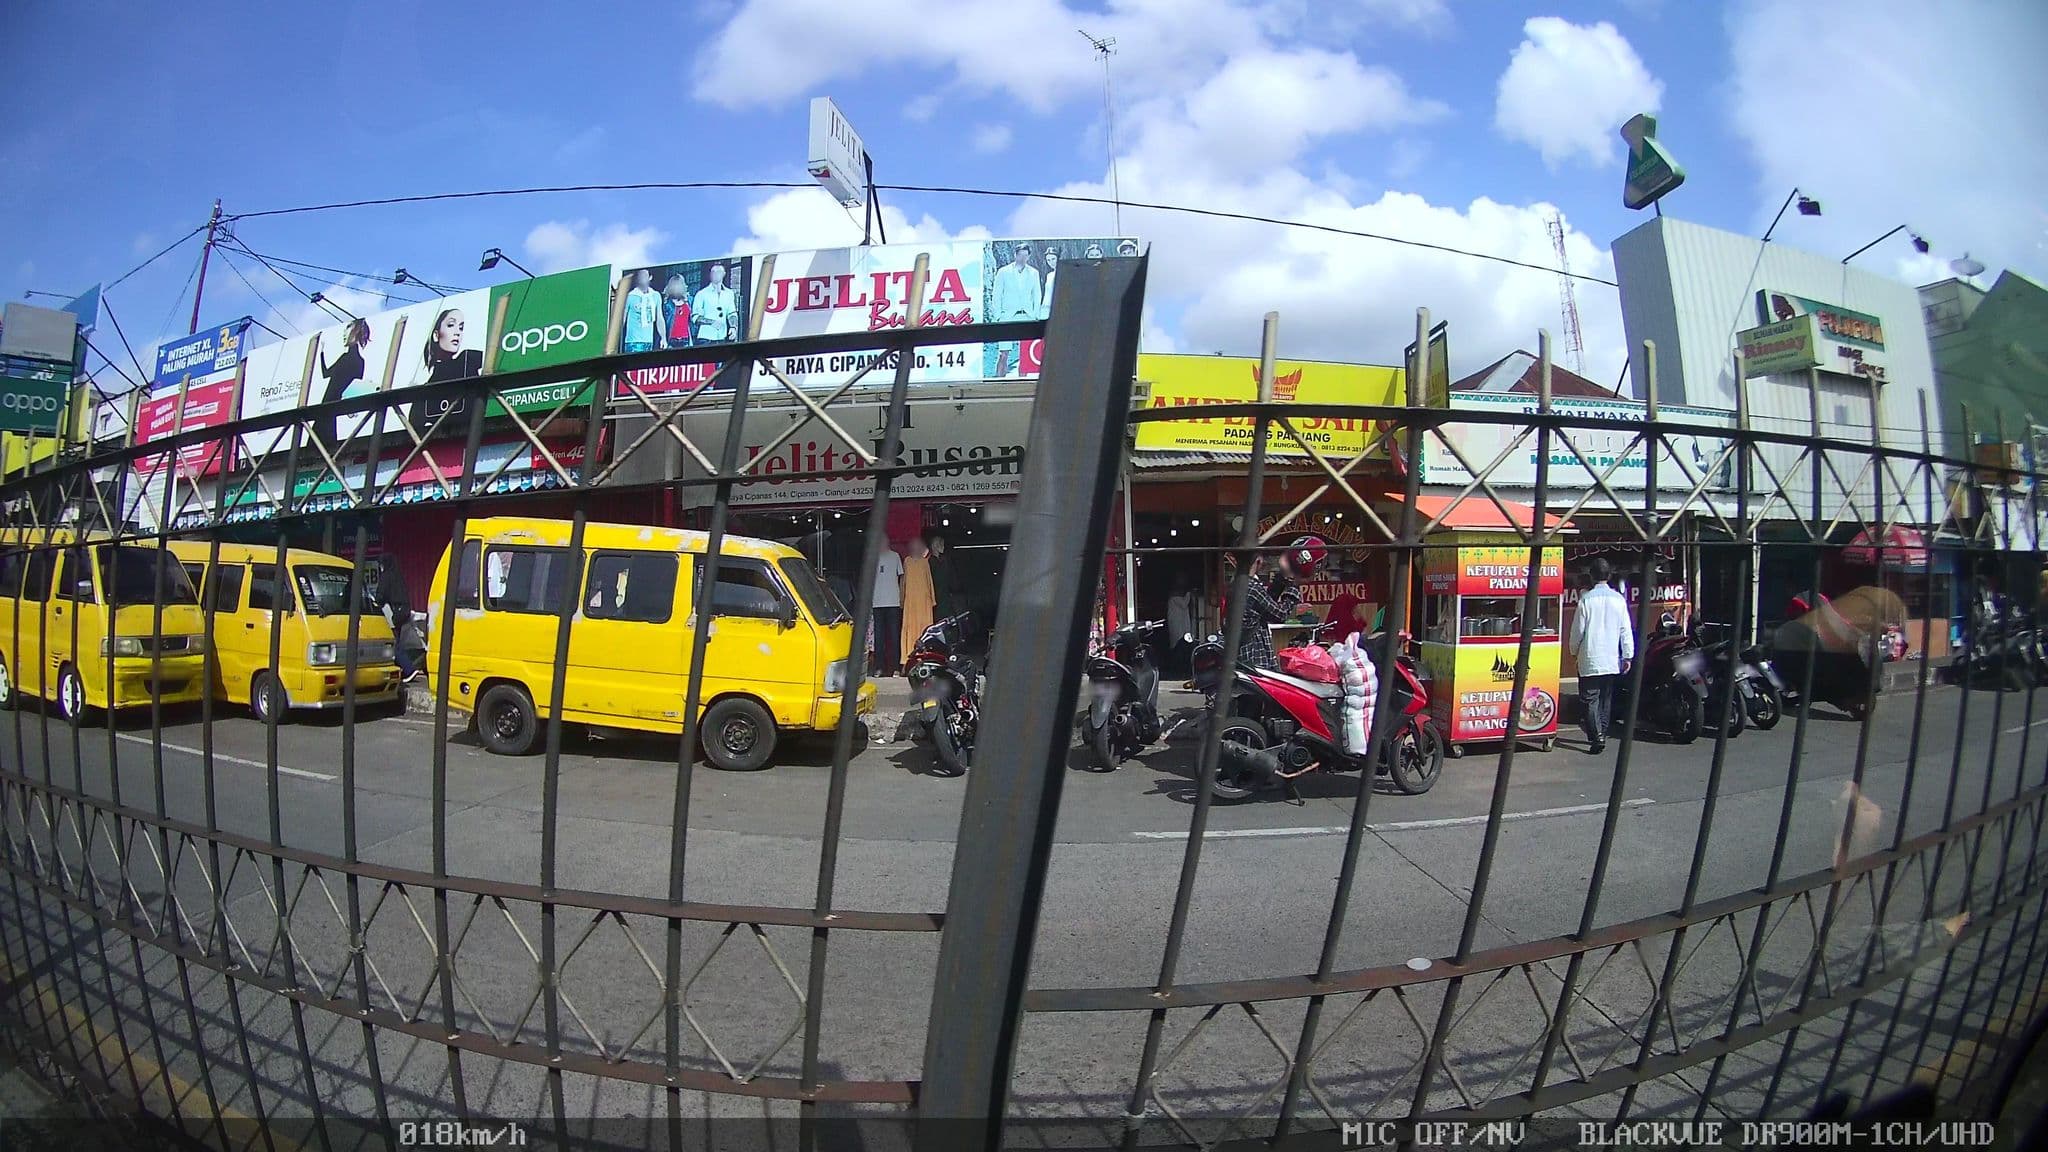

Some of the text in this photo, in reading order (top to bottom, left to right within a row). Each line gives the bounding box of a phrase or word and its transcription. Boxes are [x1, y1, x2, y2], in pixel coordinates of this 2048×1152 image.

[764, 268, 972, 314] JELITA
[868, 299, 975, 332] Buana
[501, 320, 589, 356] oppo
[168, 338, 211, 362] INTERNET XL
[162, 357, 188, 375] PALING
[187, 349, 215, 368] MURAH
[786, 354, 826, 376] RAYA
[830, 350, 899, 372] CIPANAS
[937, 350, 966, 368] 144
[2, 392, 58, 415] oppo
[505, 390, 550, 407] CIPANAS
[1522, 406, 1588, 420] RMAH
[1224, 428, 1273, 440] PADAG
[1209, 439, 1238, 447] PESANAN
[741, 437, 1025, 486] Jelita Busan
[790, 488, 818, 498] Cipanas
[851, 486, 873, 495] 43253
[890, 486, 905, 494] 813
[906, 484, 925, 493] 2024
[951, 482, 969, 491] 0821
[1466, 565, 1519, 576] KETUPAT
[1489, 578, 1529, 589] PADAN
[1631, 586, 1684, 600] PDANG
[1460, 690, 1513, 704] KETUPAT
[1460, 705, 1499, 718] SAYUR
[1460, 718, 1508, 730] PADANG
